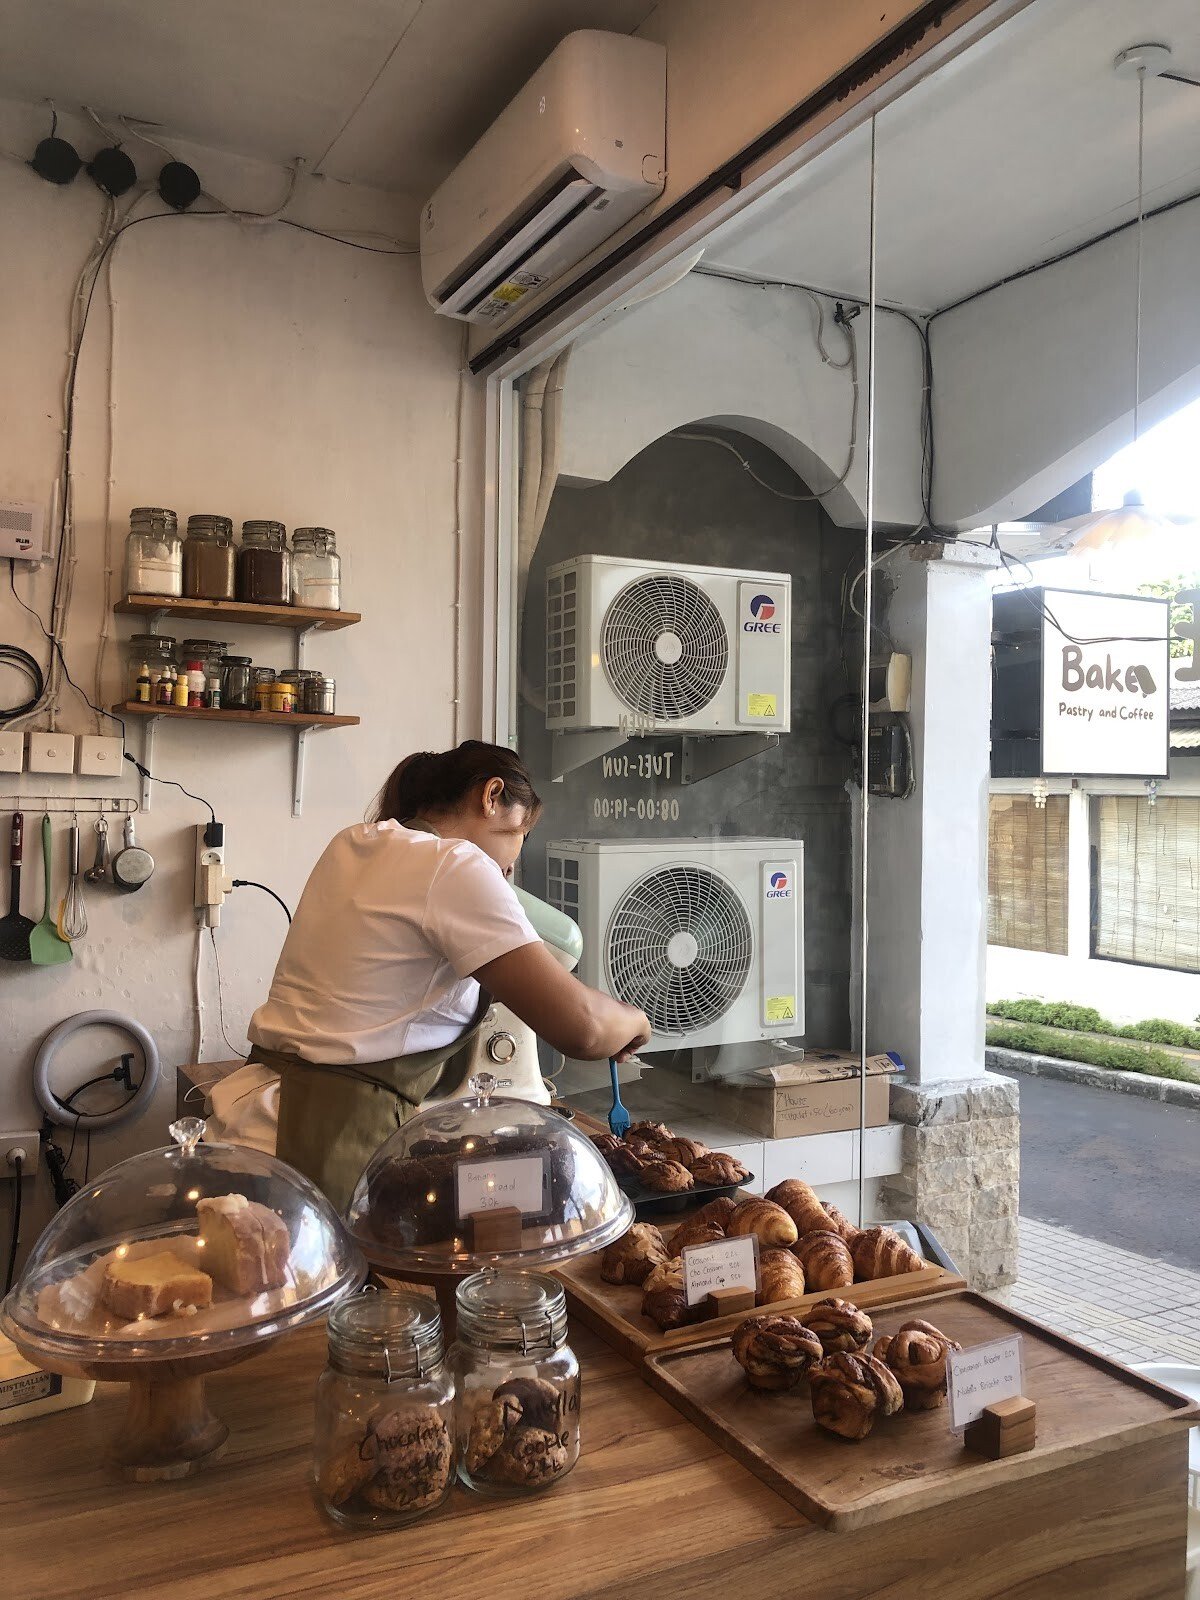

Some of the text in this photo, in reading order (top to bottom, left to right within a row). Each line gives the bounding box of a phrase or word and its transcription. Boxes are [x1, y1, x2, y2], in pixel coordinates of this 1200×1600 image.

[743, 621, 782, 634] GREE
[1059, 702, 1154, 721] Pastry and Coffee
[766, 889, 791, 898] GREE
